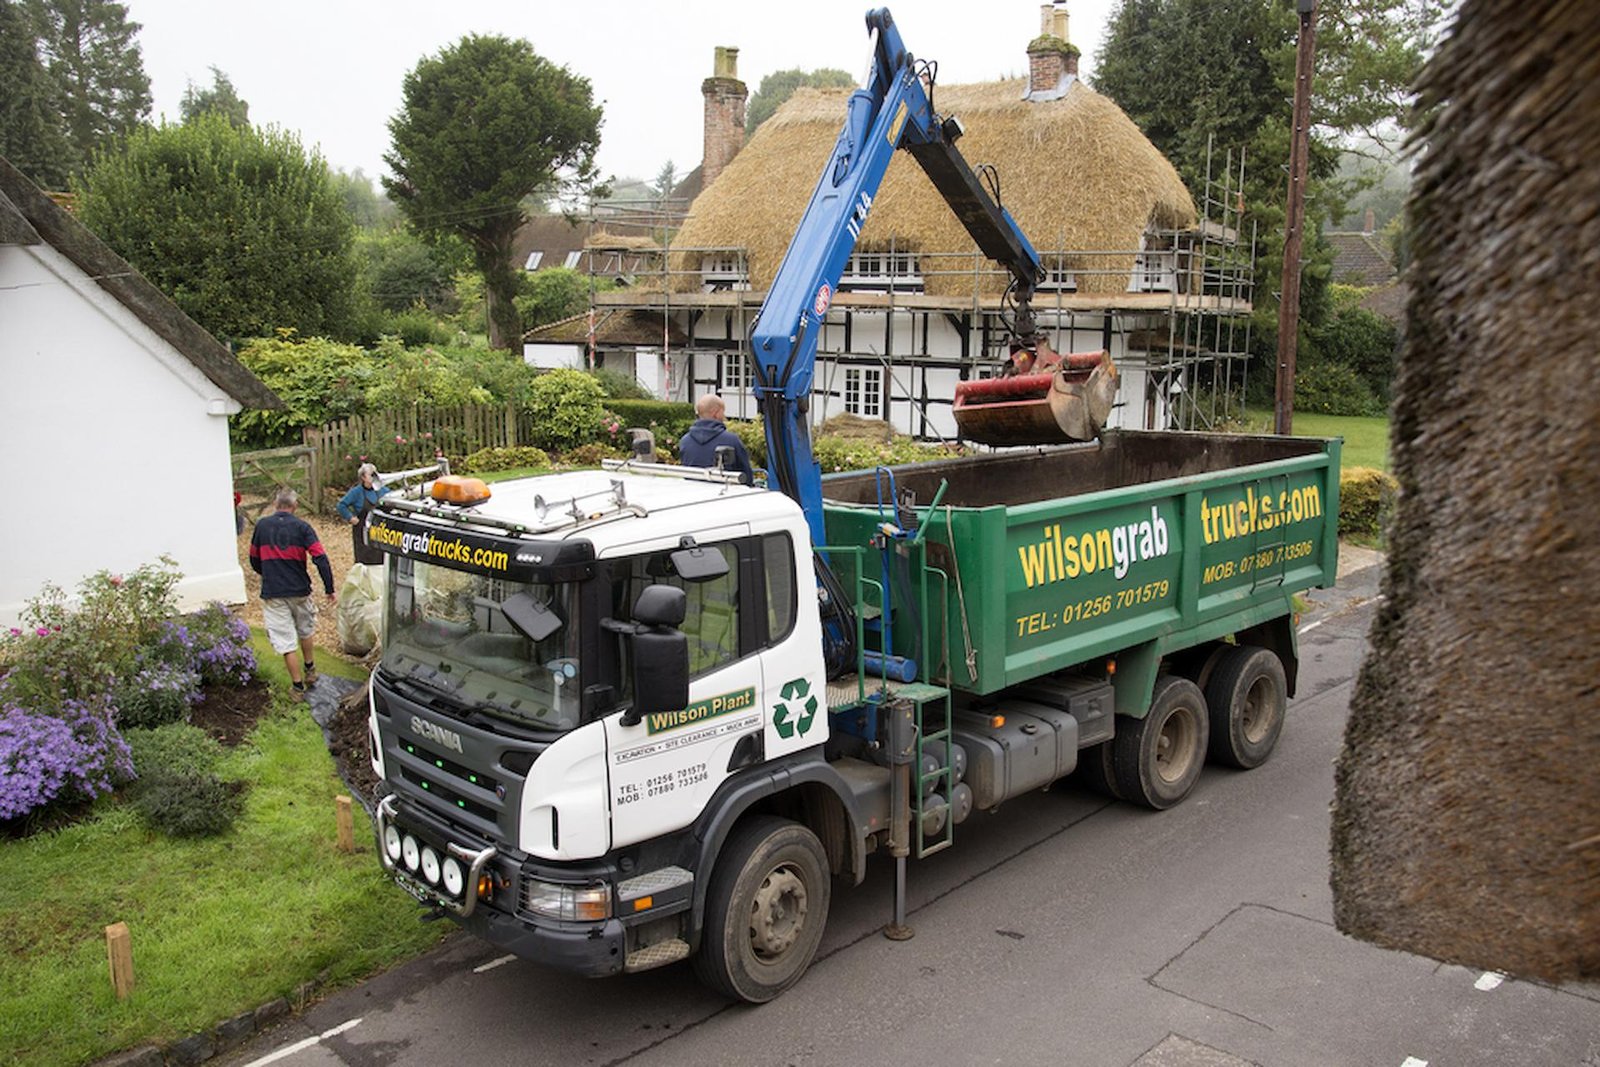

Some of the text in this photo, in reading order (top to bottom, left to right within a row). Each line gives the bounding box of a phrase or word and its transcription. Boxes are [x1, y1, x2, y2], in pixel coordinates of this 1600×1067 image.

[369, 522, 509, 571] wilsongrabtrucks.com
[1018, 485, 1321, 588] wilsongrab trucks.com
[1203, 561, 1238, 585] MOB:
[1016, 579, 1169, 637] TEL: 01256 701579
[652, 691, 750, 730] Wilson Plant
[411, 716, 464, 754] SCANIA
[616, 747, 656, 761] EXCAVATION
[665, 740, 678, 749] SITE
[680, 730, 717, 745] CLEARANCE
[620, 762, 706, 794] TEL: 01256 701579
[617, 792, 644, 806] MOB:
